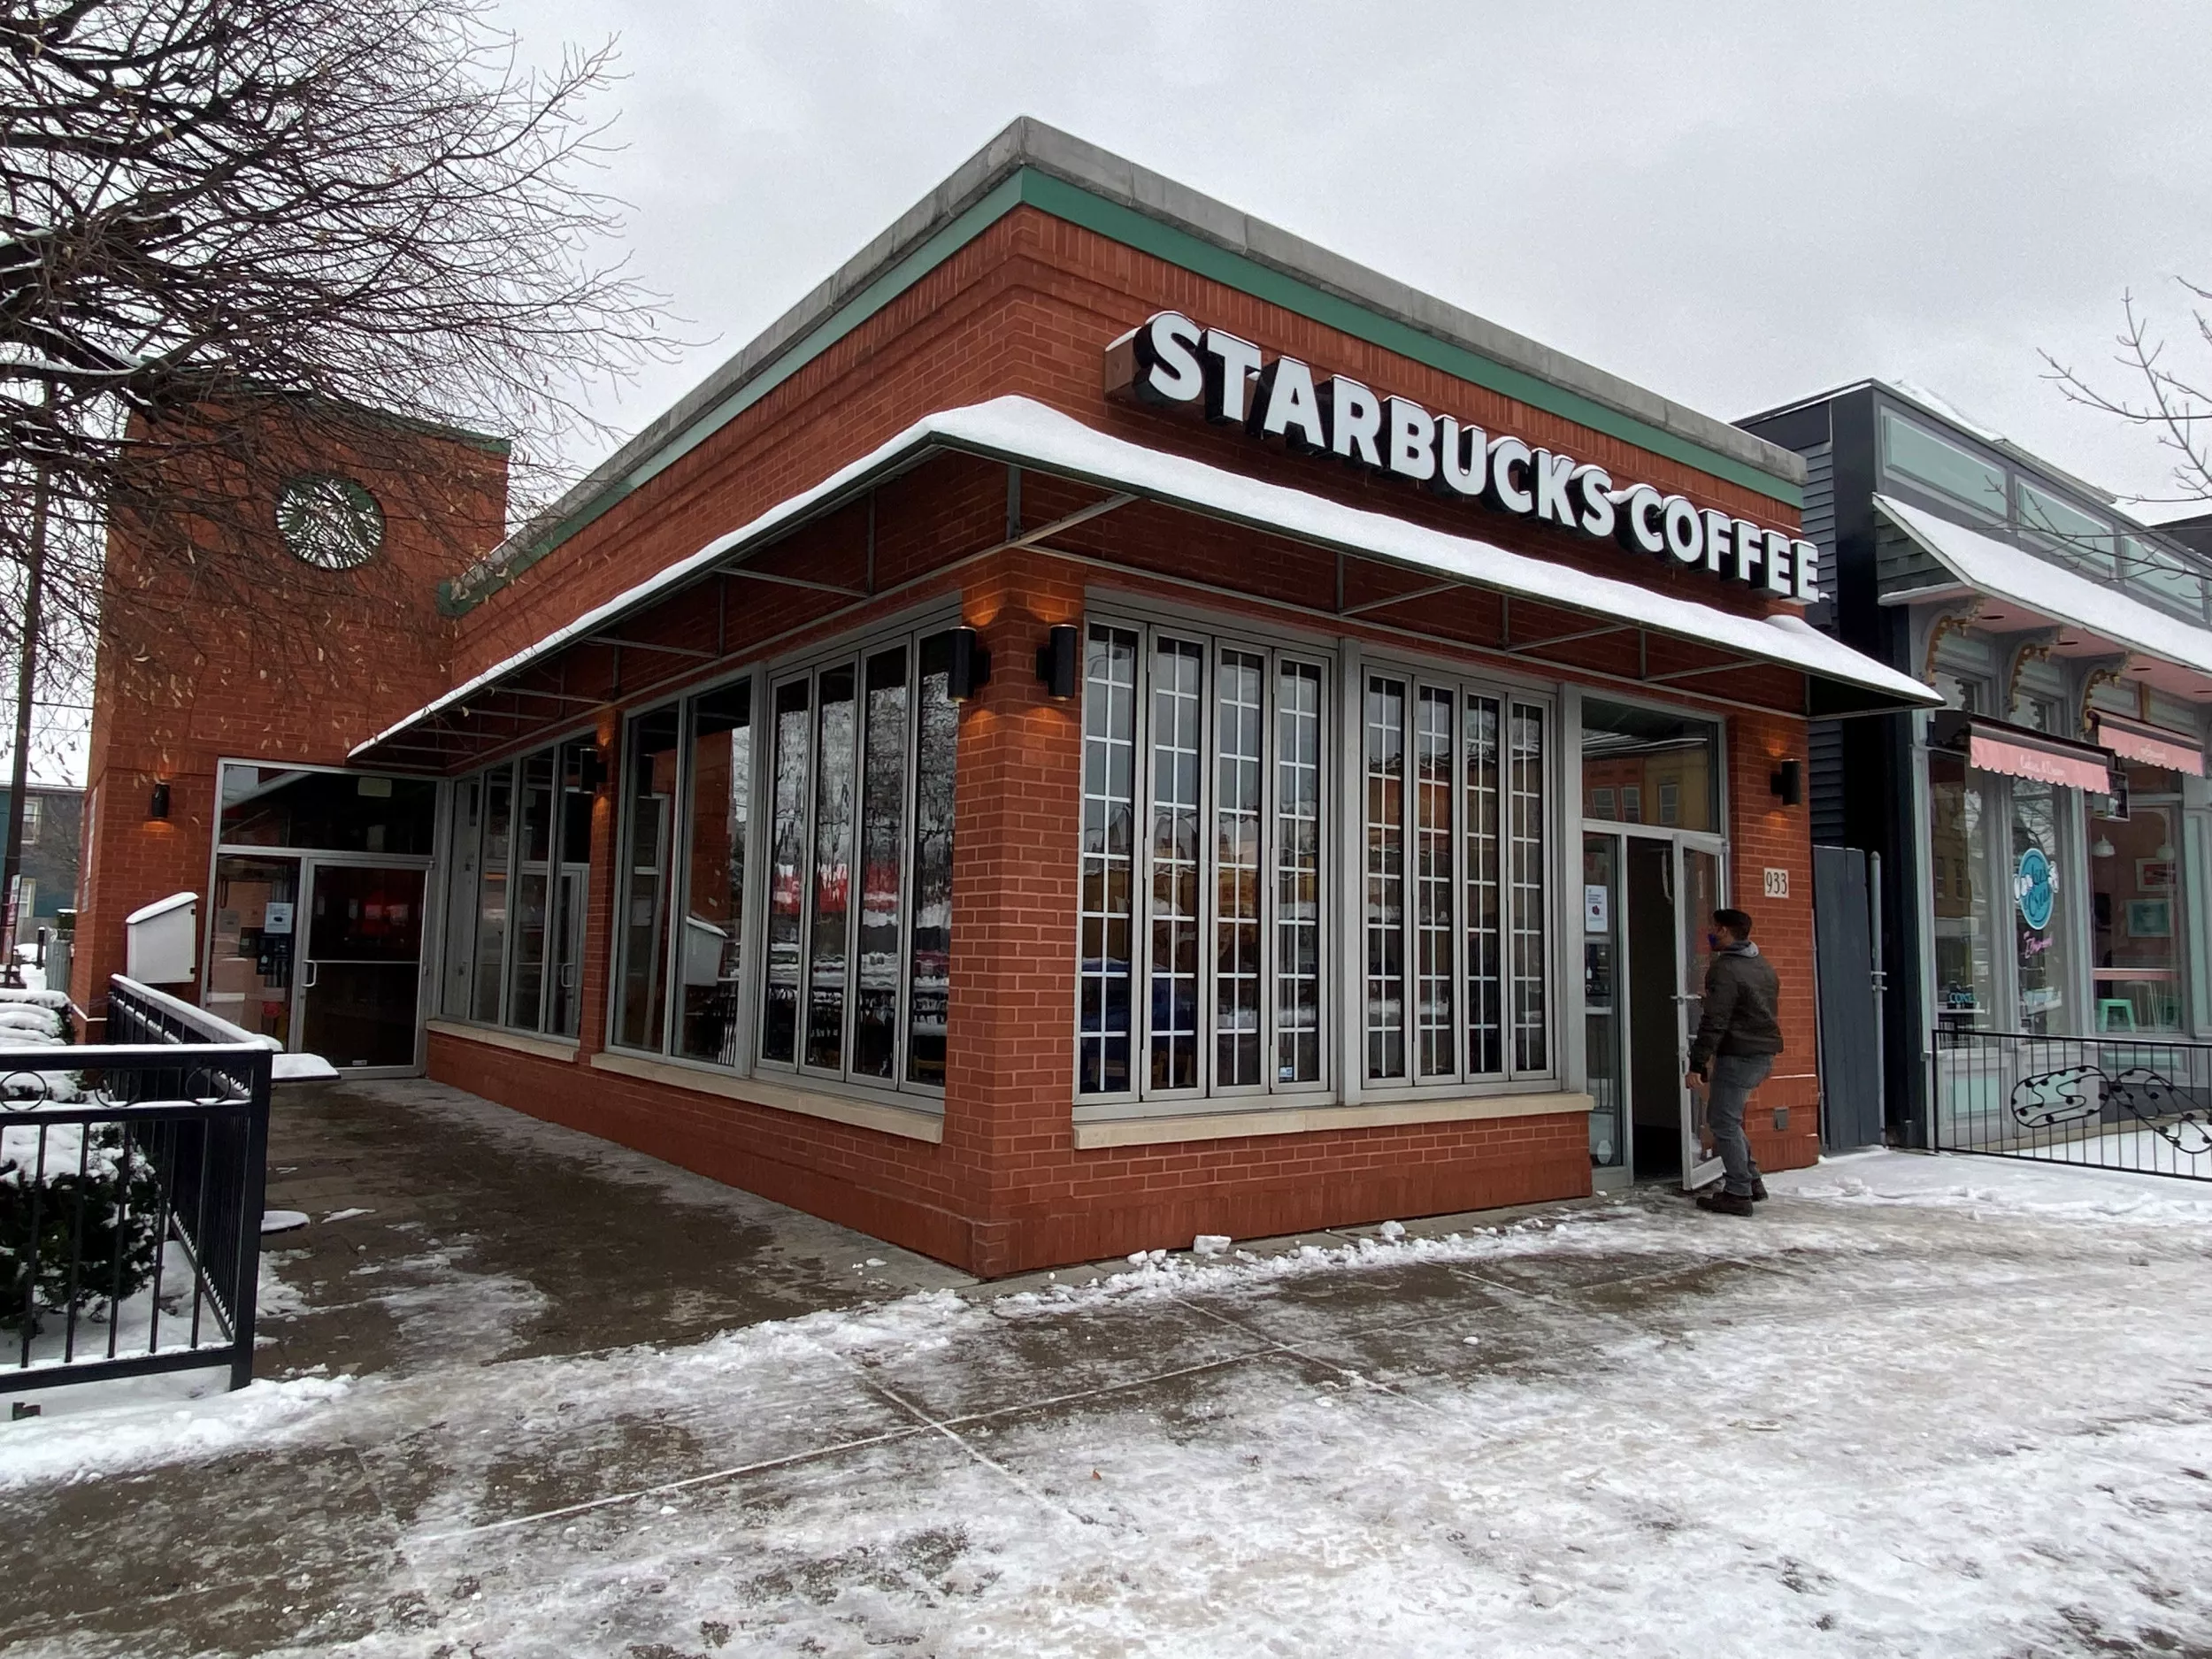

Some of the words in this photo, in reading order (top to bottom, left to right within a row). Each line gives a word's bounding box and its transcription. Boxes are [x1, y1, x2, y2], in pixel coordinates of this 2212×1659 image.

[1149, 312, 1616, 537] STARBUCKS
[1631, 487, 1819, 603] COFFEE
[1766, 871, 1787, 895] 933
